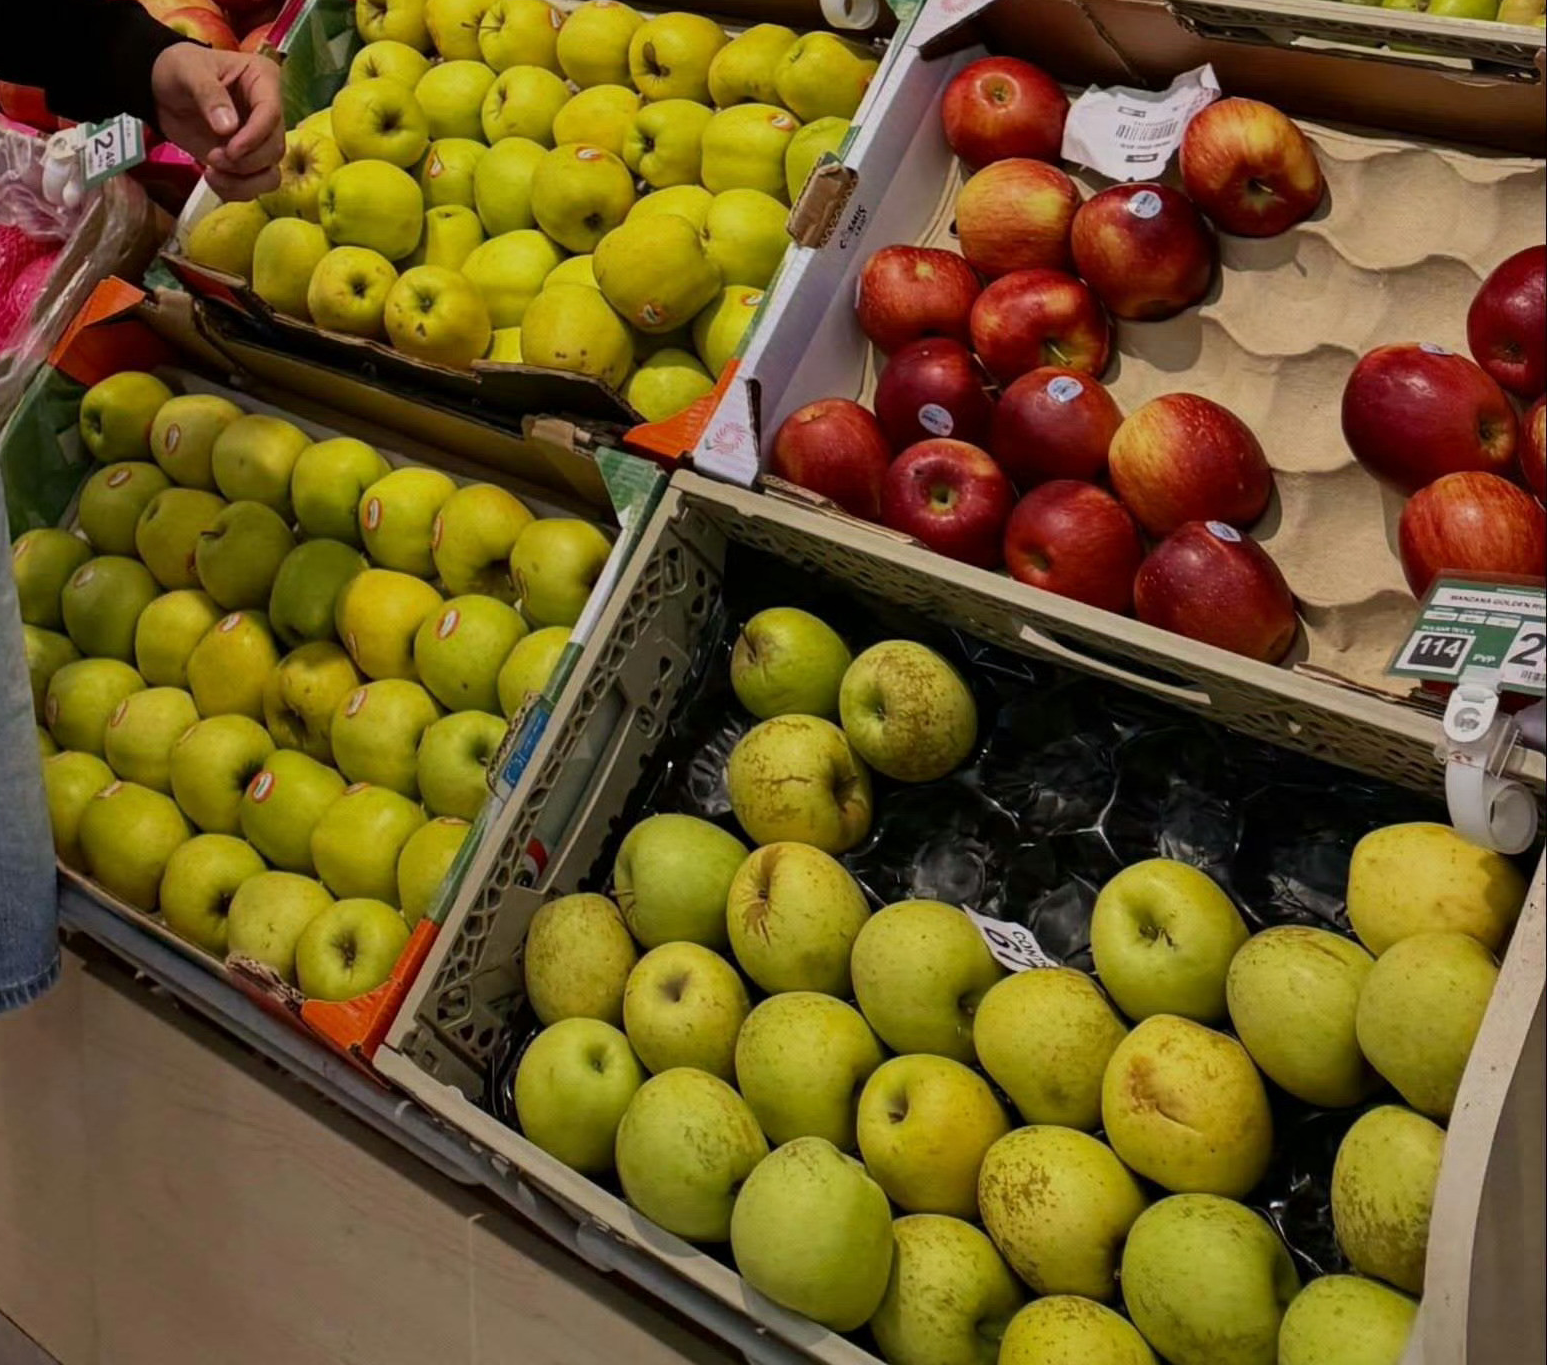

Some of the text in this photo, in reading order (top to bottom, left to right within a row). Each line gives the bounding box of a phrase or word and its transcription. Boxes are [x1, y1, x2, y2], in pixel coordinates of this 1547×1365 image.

[1450, 595, 1492, 604] MANZANA
[1493, 598, 1531, 609] GOLDEN
[1420, 624, 1450, 632] PULSAR
[1420, 637, 1462, 658] 114
